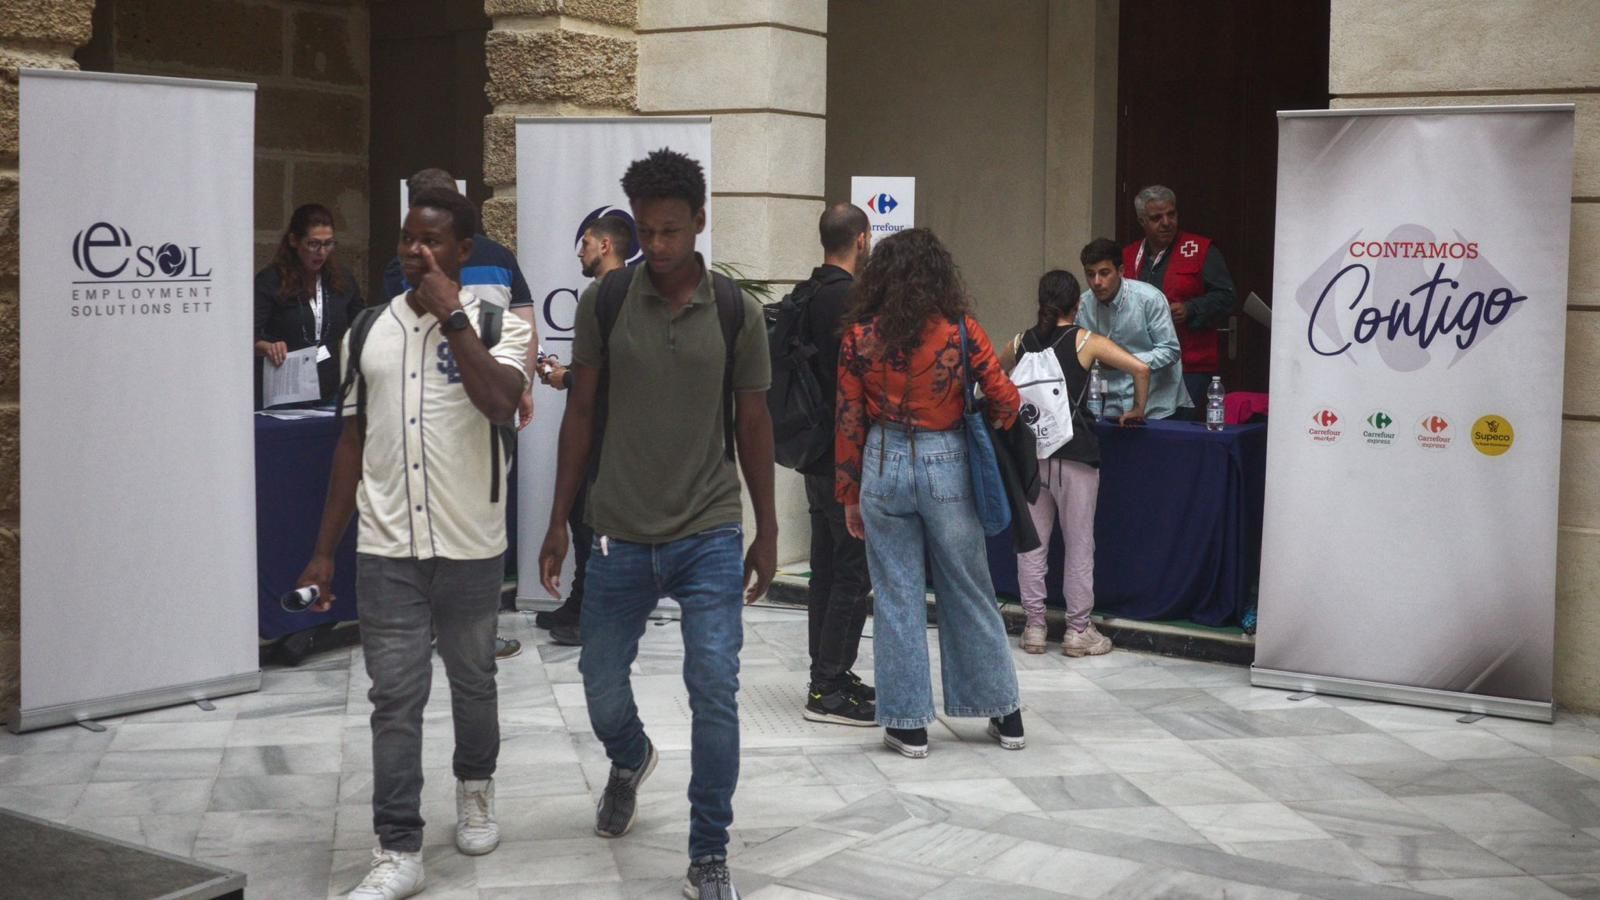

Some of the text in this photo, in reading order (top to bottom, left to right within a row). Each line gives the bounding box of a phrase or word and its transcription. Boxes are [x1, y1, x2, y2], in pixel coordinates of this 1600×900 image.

[872, 222, 905, 232] rrefour
[1349, 241, 1479, 259] CONTAMOS
[71, 286, 213, 301] EMPLOYMENT
[71, 302, 213, 317] SOLUTIONS ETT
[1307, 262, 1528, 357] Contigo
[1308, 428, 1341, 437] Carrefour
[1362, 430, 1396, 439] Carrefour
[1474, 431, 1510, 442] Supeco
[1417, 434, 1451, 443] Carrefour
